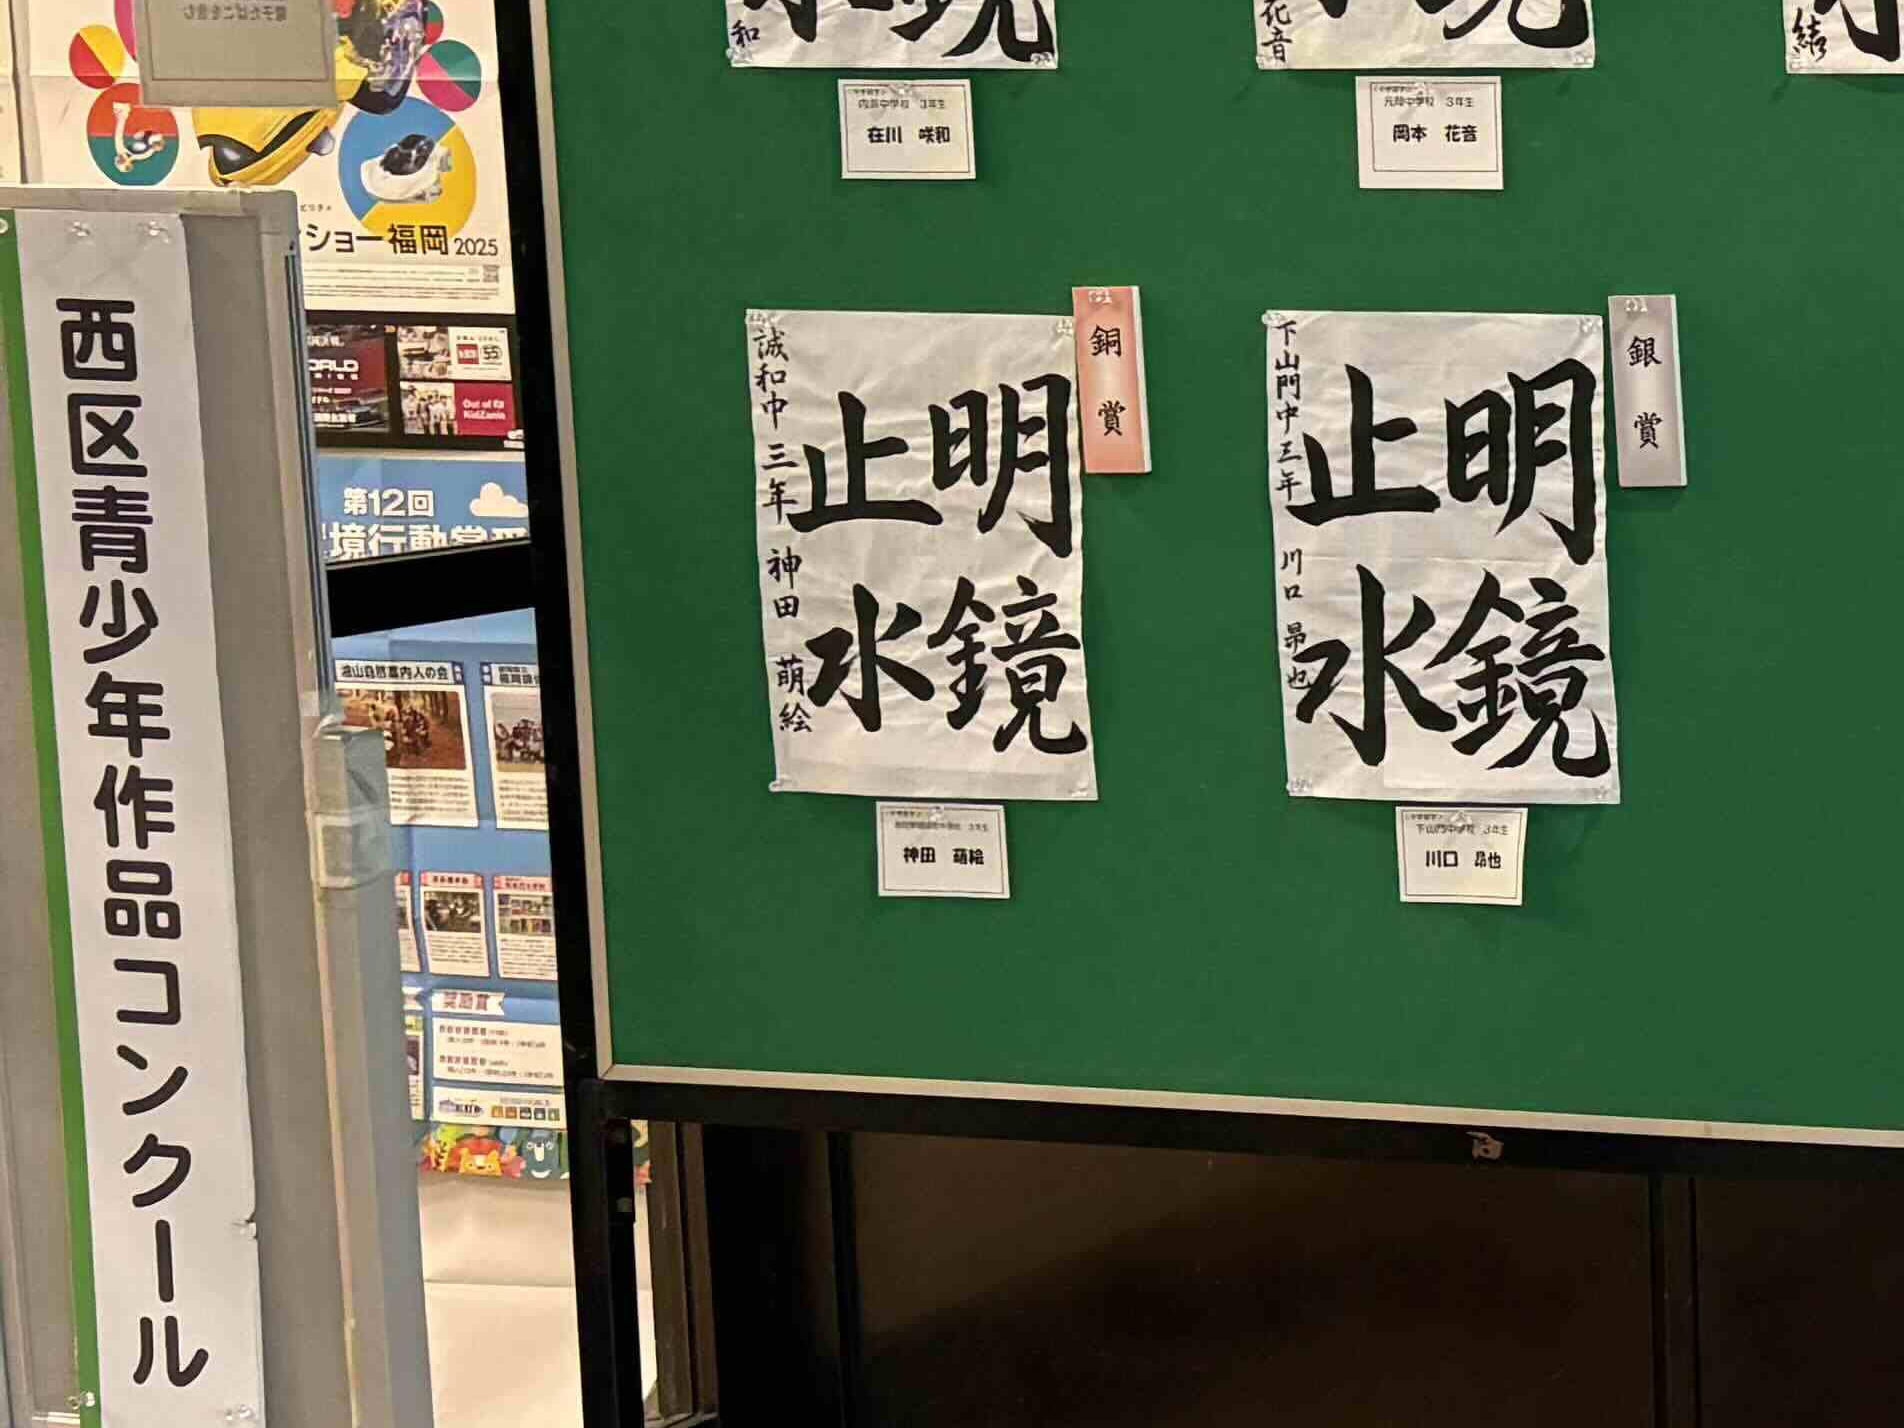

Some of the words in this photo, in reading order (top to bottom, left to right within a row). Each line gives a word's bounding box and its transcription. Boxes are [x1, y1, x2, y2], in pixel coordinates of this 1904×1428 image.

[867, 126, 902, 144] 在川
[1393, 124, 1427, 143] 岡本
[1445, 124, 1477, 143] 花音
[454, 238, 498, 256] 2025
[1089, 324, 1126, 436] 銅賞
[1626, 335, 1662, 449] 銀賞
[344, 487, 434, 516] 第12回
[321, 522, 528, 560] 境行動
[787, 391, 943, 732] 止水
[927, 372, 1088, 756] 明鏡
[1286, 363, 1456, 767] 止水
[1425, 358, 1612, 778] 明鏡
[55, 296, 209, 1389] 西区青少年作品コンクール
[904, 847, 936, 863] 神田
[1426, 851, 1458, 868] 川口
